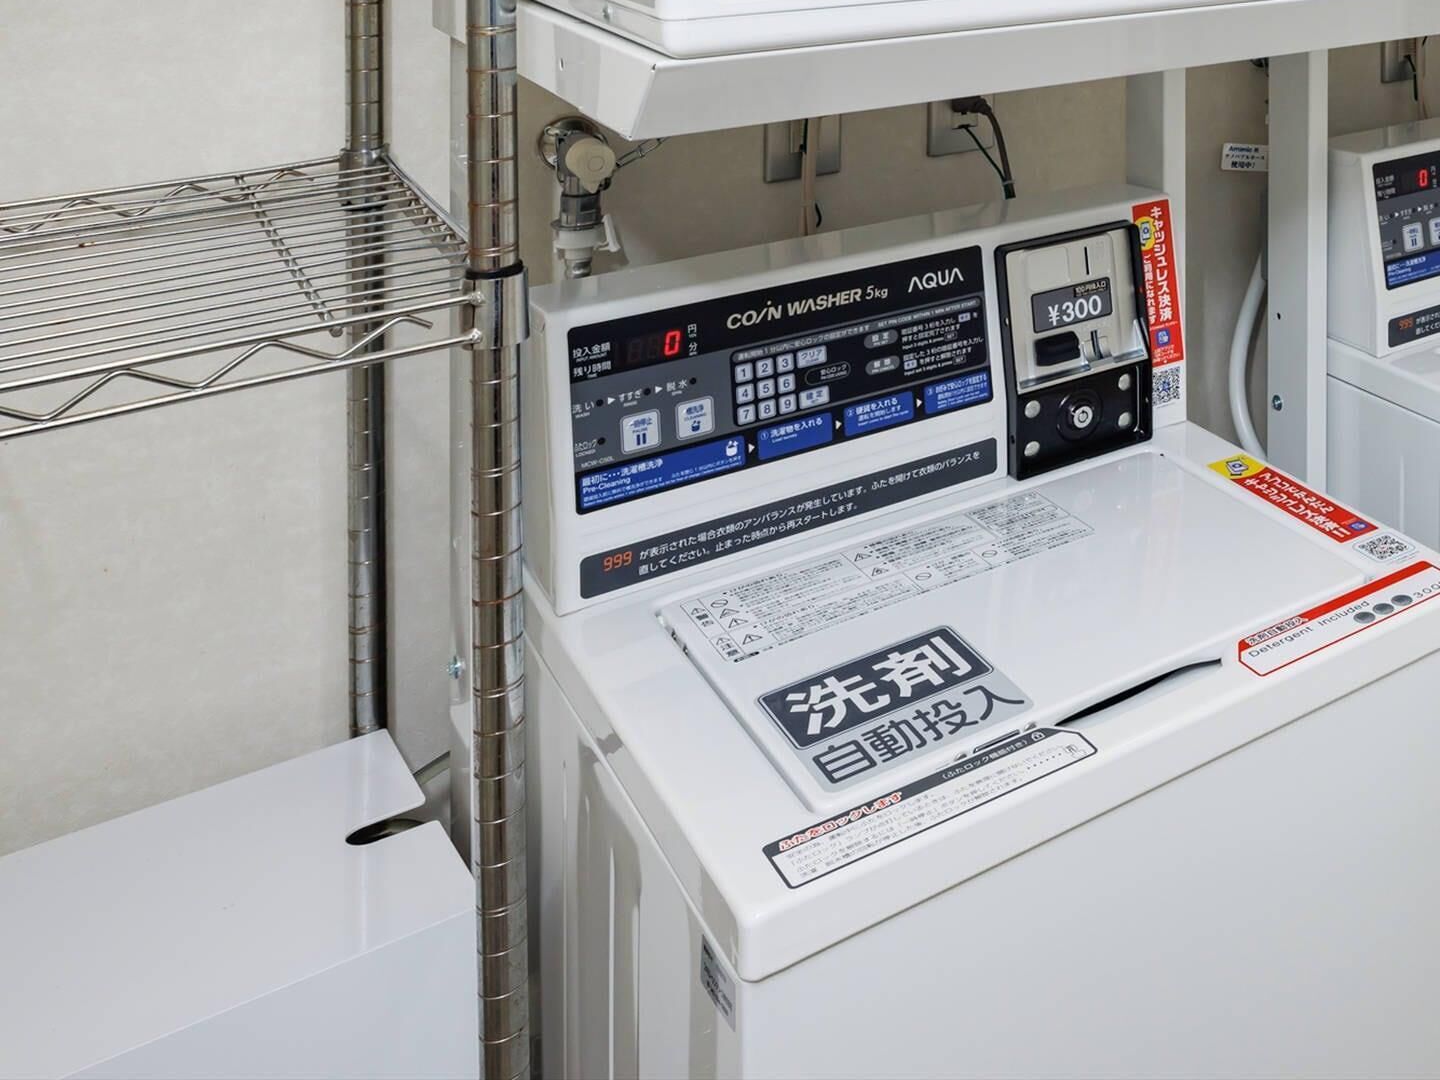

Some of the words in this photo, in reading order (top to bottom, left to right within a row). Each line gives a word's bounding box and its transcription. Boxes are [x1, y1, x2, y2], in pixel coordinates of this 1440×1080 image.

[1418, 168, 1428, 187] 0
[908, 267, 964, 293] AQUA
[787, 287, 862, 318] WASHER
[865, 284, 888, 299] 5kg
[1048, 294, 1102, 326] ¥300
[687, 323, 697, 334] 円
[573, 342, 611, 360] 投入金額
[664, 330, 681, 356] 0
[688, 342, 698, 352] 分
[573, 361, 611, 377] 残り時間
[741, 367, 747, 378] 1
[761, 363, 768, 373] 2
[781, 358, 789, 368] 3
[618, 388, 642, 402] すすぎ
[666, 379, 688, 393] 脱水
[742, 389, 749, 399] 4
[763, 383, 770, 394] 5
[783, 378, 790, 388] 6
[743, 410, 750, 420] 7
[763, 403, 771, 414] 8
[784, 398, 791, 409] 9
[855, 396, 897, 416] 硬貨を入れる
[771, 416, 822, 439] 洗濯物を入れる
[583, 477, 631, 494] Pre-Cleaning
[603, 550, 633, 572] 999
[1248, 626, 1314, 658] Detergent
[785, 635, 972, 735] 洗剤
[812, 685, 1025, 784] 自動投入
